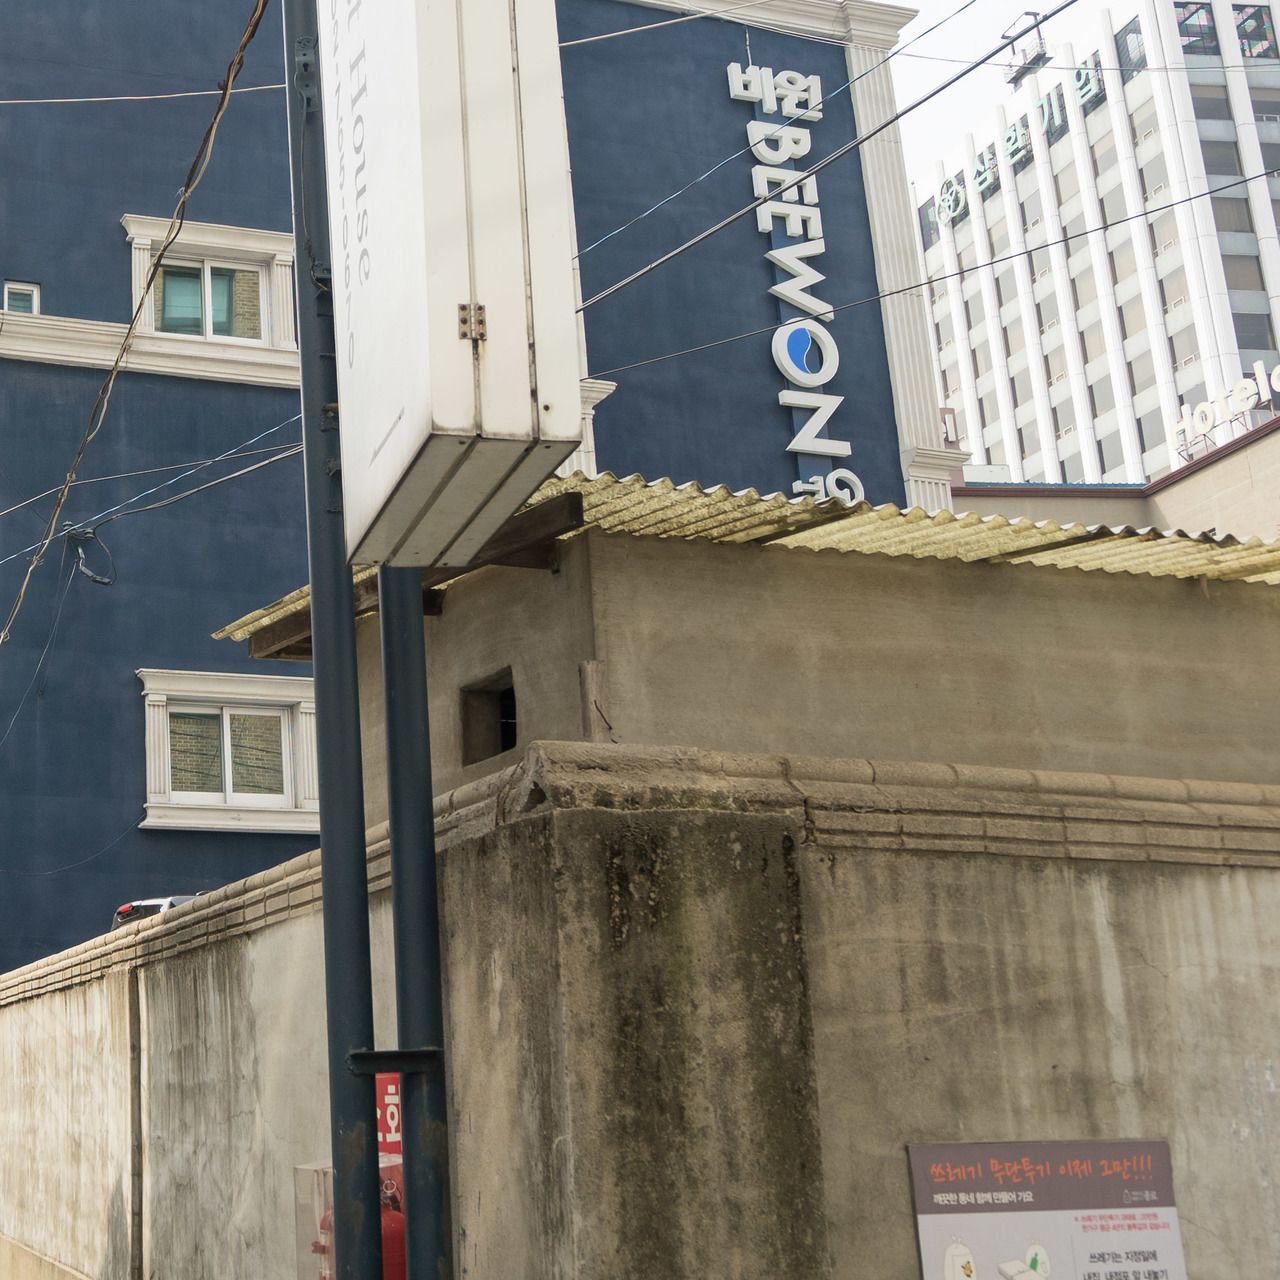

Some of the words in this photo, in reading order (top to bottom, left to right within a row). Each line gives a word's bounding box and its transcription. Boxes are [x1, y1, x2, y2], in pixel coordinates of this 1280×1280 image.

[727, 62, 823, 122] 비원
[348, 38, 371, 287] House
[746, 120, 852, 457] BEEWON
[930, 1161, 983, 1182] 쓰레기
[989, 1156, 1051, 1184] 무단투기
[1058, 1159, 1092, 1179] 이제
[1099, 1152, 1153, 1181] 그만!!!
[1089, 1252, 1123, 1263] 쓰레기는
